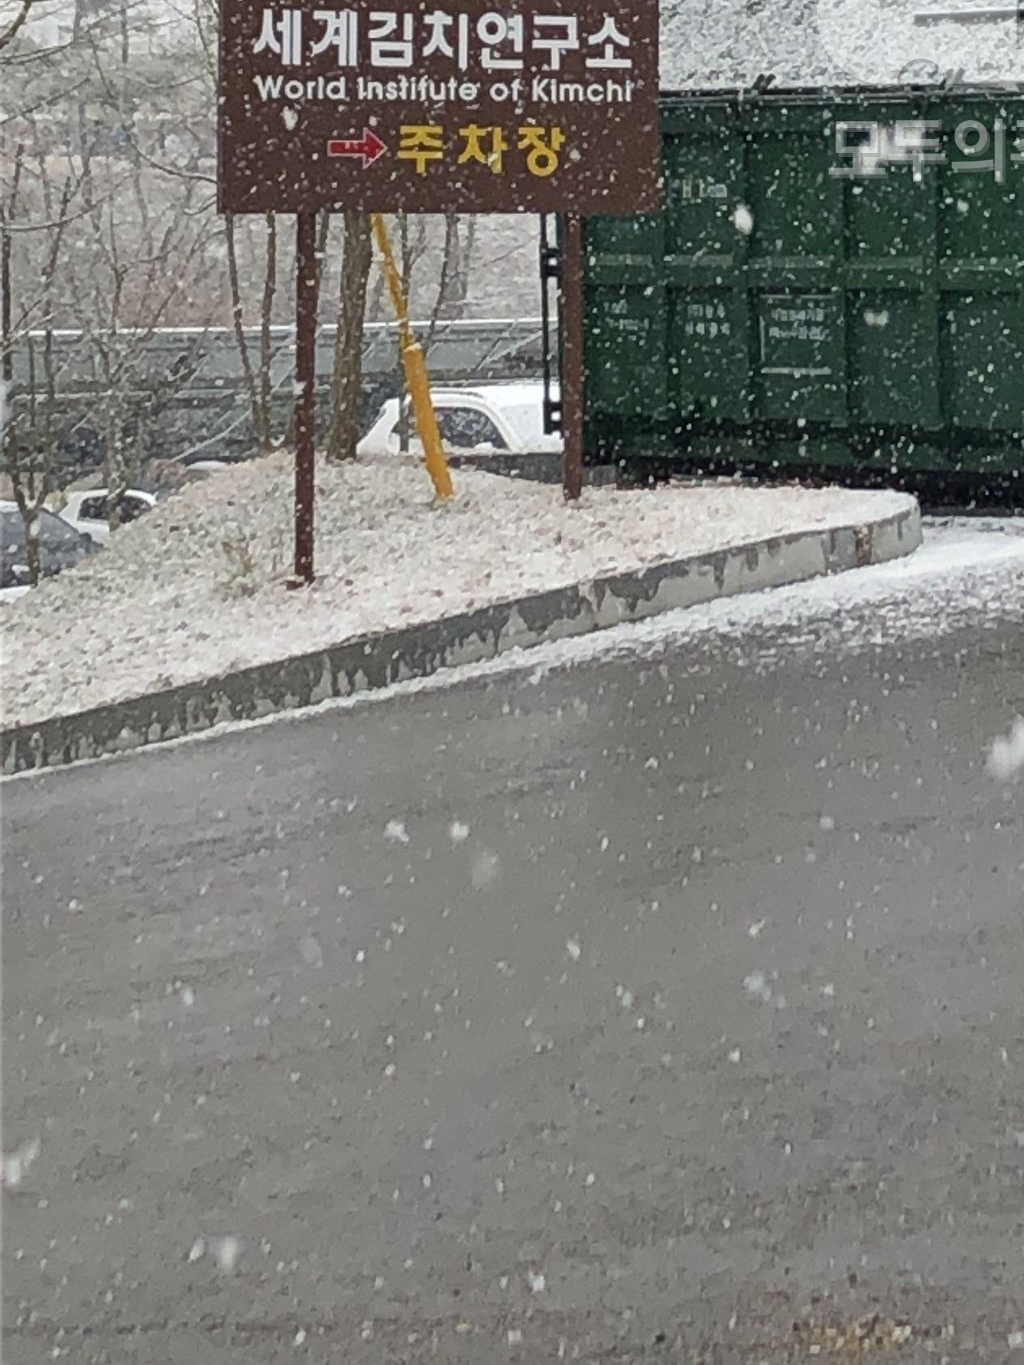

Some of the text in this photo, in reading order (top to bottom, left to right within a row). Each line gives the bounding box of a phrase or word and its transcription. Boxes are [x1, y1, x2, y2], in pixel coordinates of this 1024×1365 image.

[253, 8, 632, 70] 세계김치연구소
[256, 75, 634, 103] World Institute of Kimchi
[398, 124, 566, 177] 주차장
